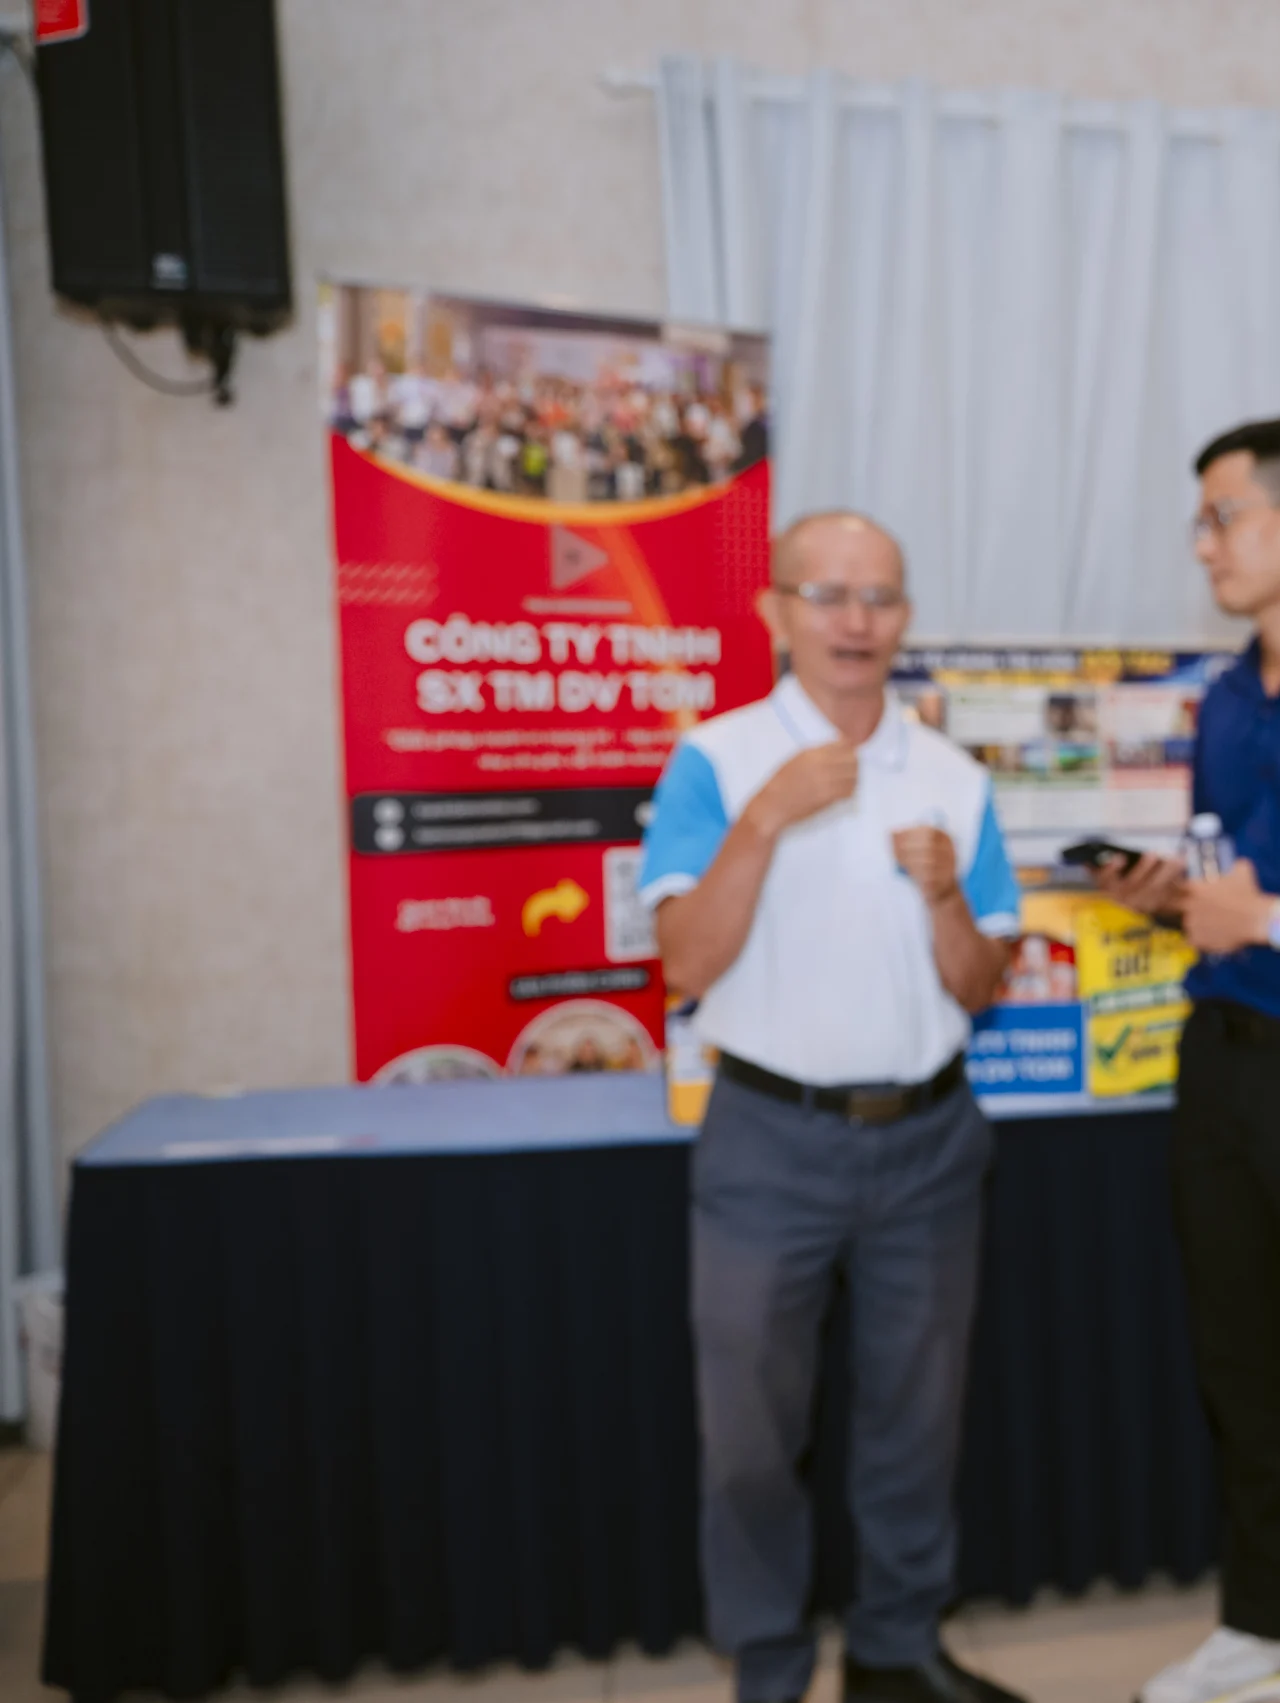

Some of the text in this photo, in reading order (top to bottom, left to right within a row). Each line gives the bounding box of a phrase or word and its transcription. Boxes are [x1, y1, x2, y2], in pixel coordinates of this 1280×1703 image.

[405, 613, 722, 666] CÔNG TY TNHH
[416, 669, 485, 714] SX
[486, 669, 555, 713] TM
[556, 669, 626, 713] DV
